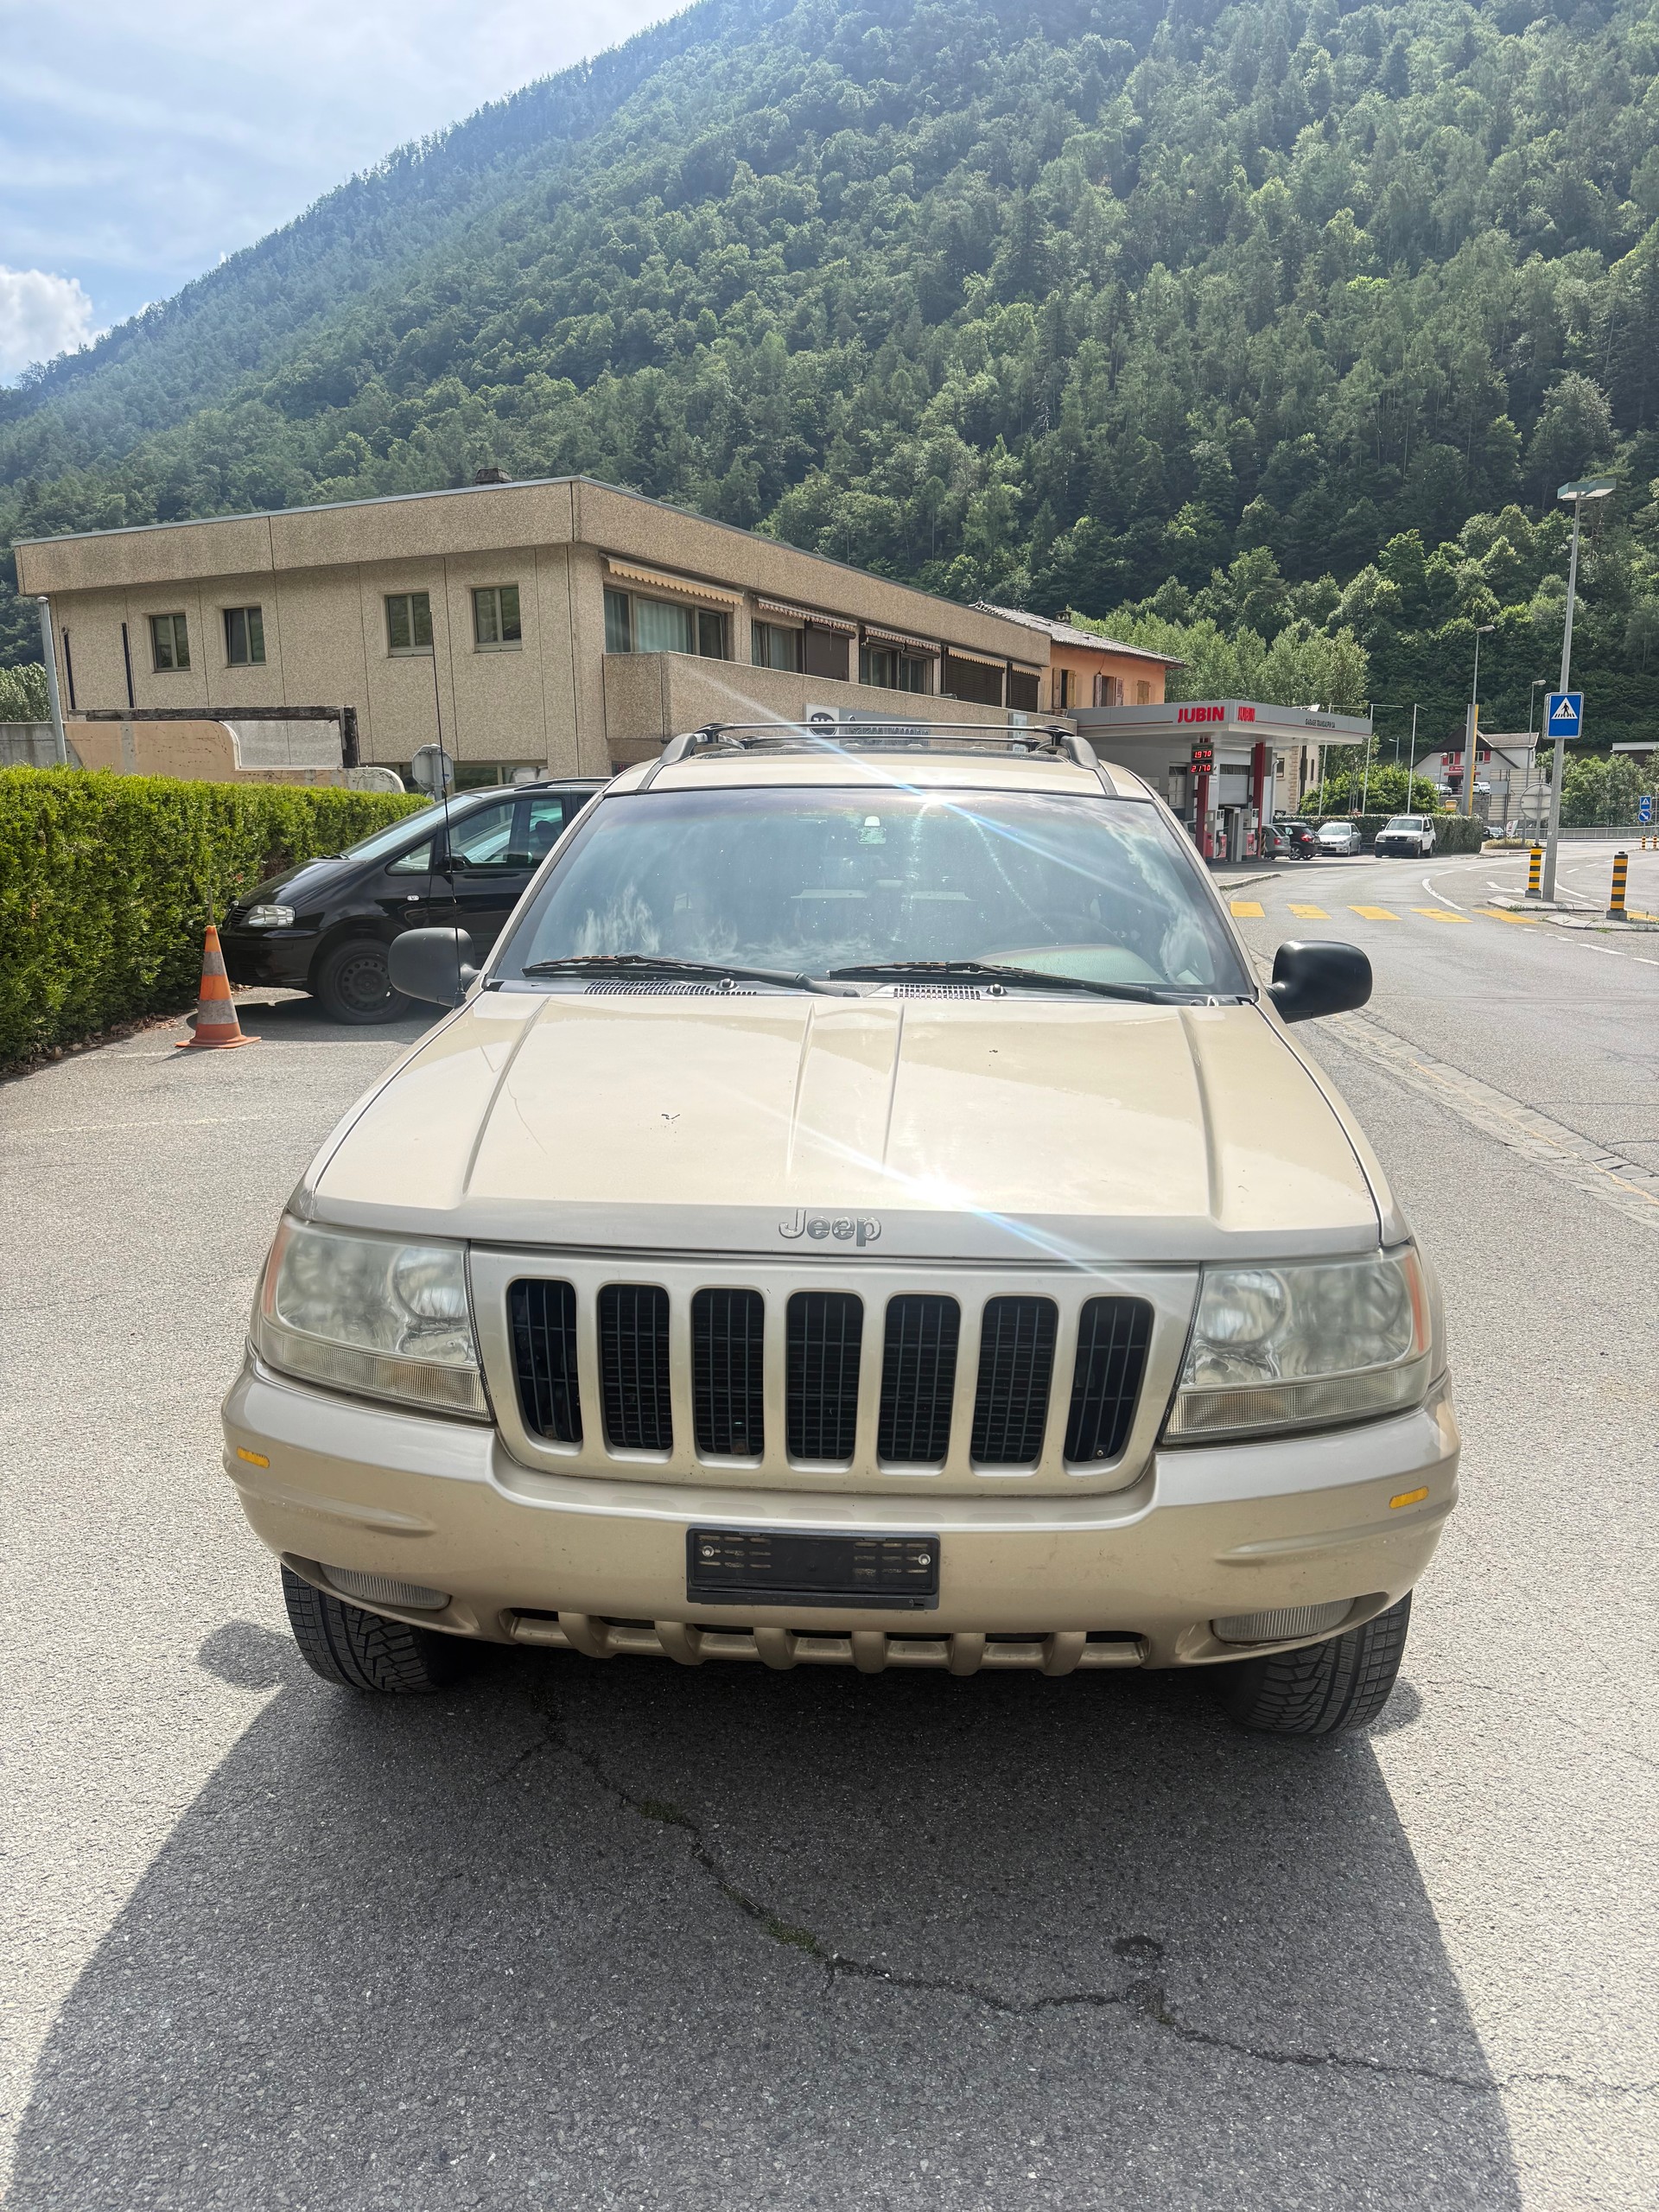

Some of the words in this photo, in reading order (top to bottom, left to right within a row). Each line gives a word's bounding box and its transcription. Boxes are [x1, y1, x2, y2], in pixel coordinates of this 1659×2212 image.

[1178, 706, 1224, 723] JUBIN
[1238, 706, 1255, 722] JUBIN
[779, 1209, 881, 1247] Jeep
